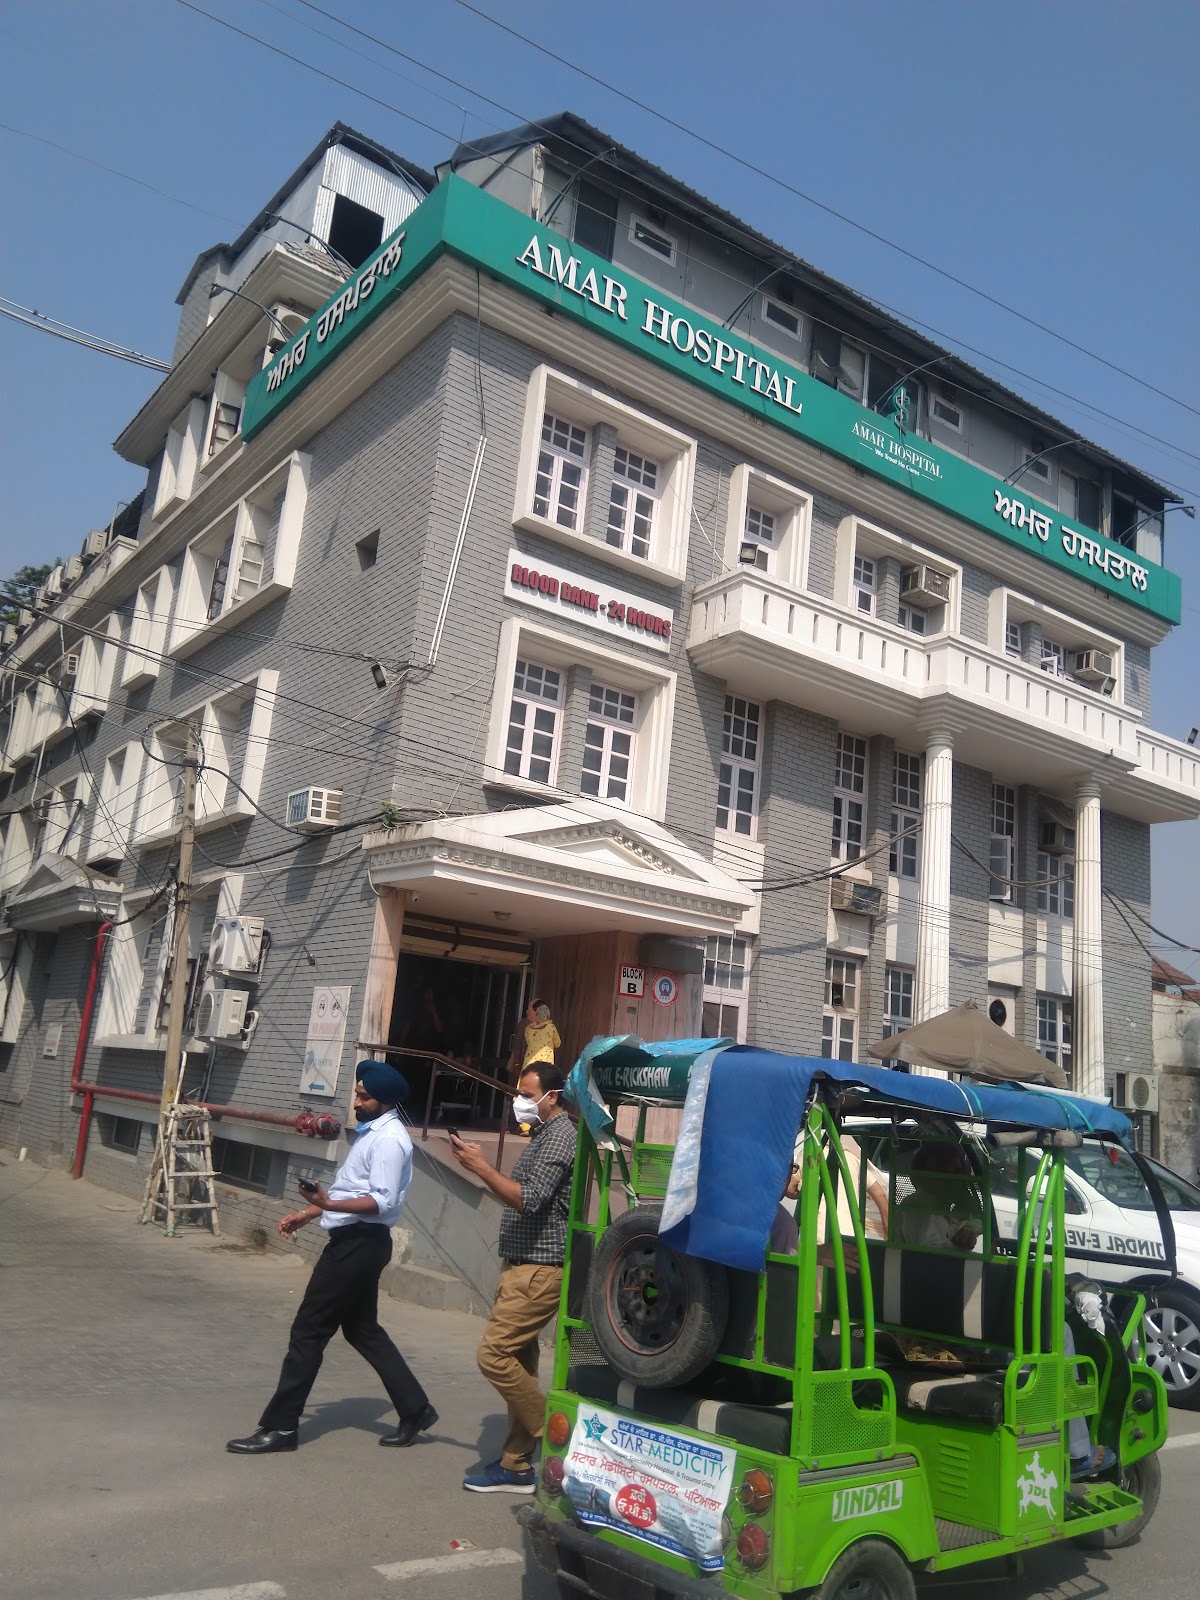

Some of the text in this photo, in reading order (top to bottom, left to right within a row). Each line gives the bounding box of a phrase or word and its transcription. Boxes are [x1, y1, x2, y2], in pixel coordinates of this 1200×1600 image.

[266, 231, 406, 392] ਅਮਰ ਹਸਪਤਾਲ
[516, 235, 803, 415] AMAR HOSPITAL
[851, 422, 943, 479] AMAR HOSPITAL
[994, 489, 1149, 591] ਅਮਰ ਹਸਪਤਾਲ
[511, 564, 560, 597] BLOOD
[560, 581, 600, 612] BANK
[607, 599, 627, 621] 24
[627, 607, 672, 638] HOURS
[622, 967, 644, 981] BLOCK
[627, 982, 637, 994] B
[615, 1066, 672, 1089] E-RICKSHAW
[610, 1429, 728, 1480] STAR MEDICITY
[654, 1463, 675, 1476] Hospital
[681, 1472, 701, 1485] Trauma
[571, 1450, 597, 1467] ਸਟਾਰ
[684, 1487, 722, 1511] ਪਟਿਆਲਾ
[834, 1481, 903, 1520] JINDAL
[1027, 1484, 1048, 1499] JDL
